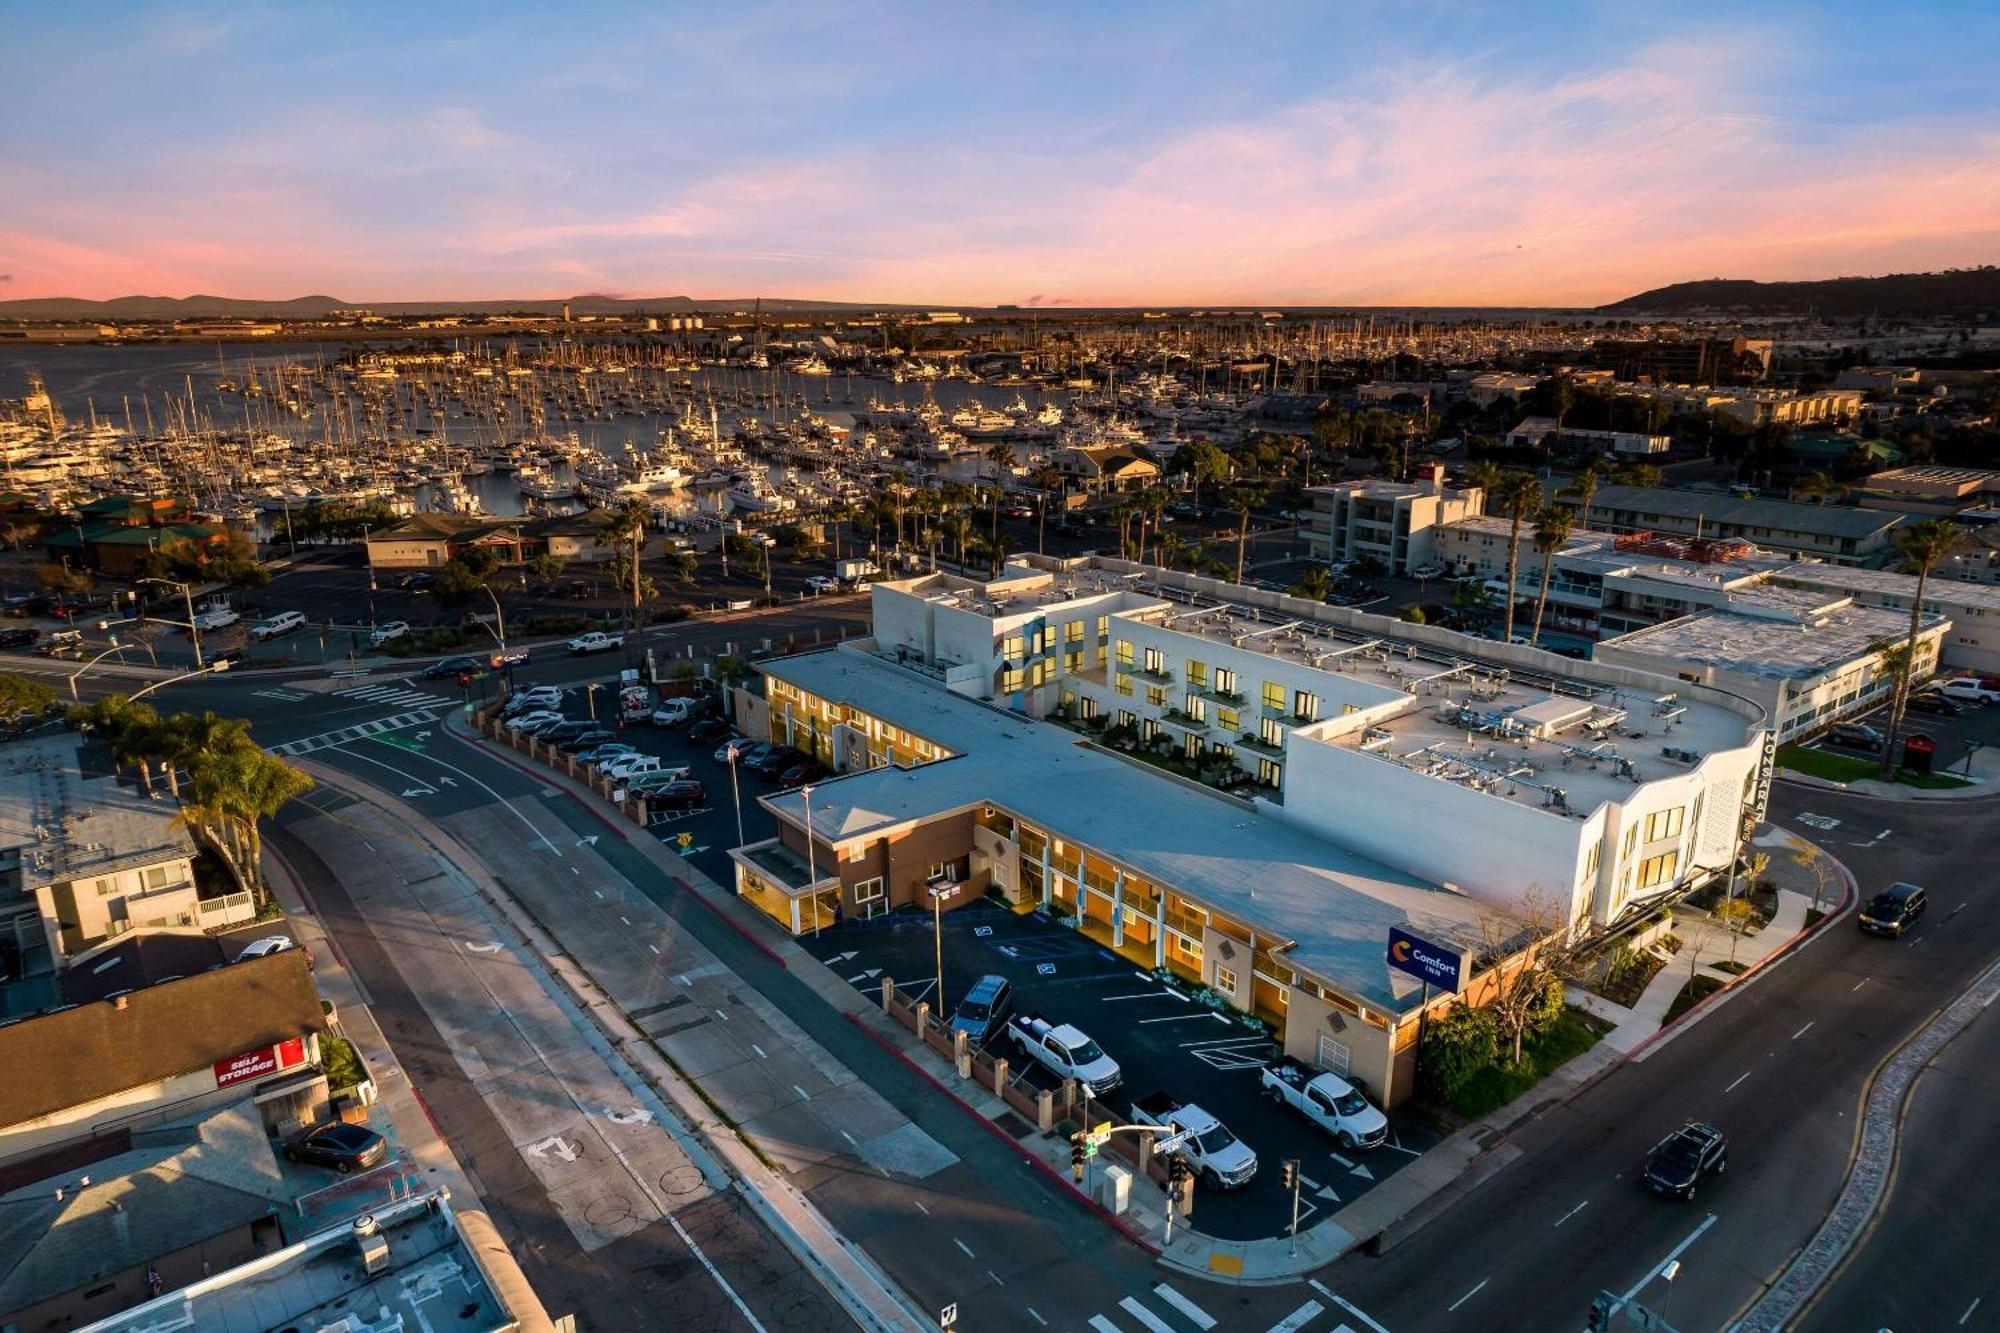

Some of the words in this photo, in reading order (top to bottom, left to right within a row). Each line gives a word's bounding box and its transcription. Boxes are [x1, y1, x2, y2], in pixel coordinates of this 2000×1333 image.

[1755, 733, 1778, 822] MONSARAZ
[1413, 949, 1456, 976] Comfort
[219, 1059, 275, 1083] STORAGE
[231, 1055, 260, 1070] SELF
